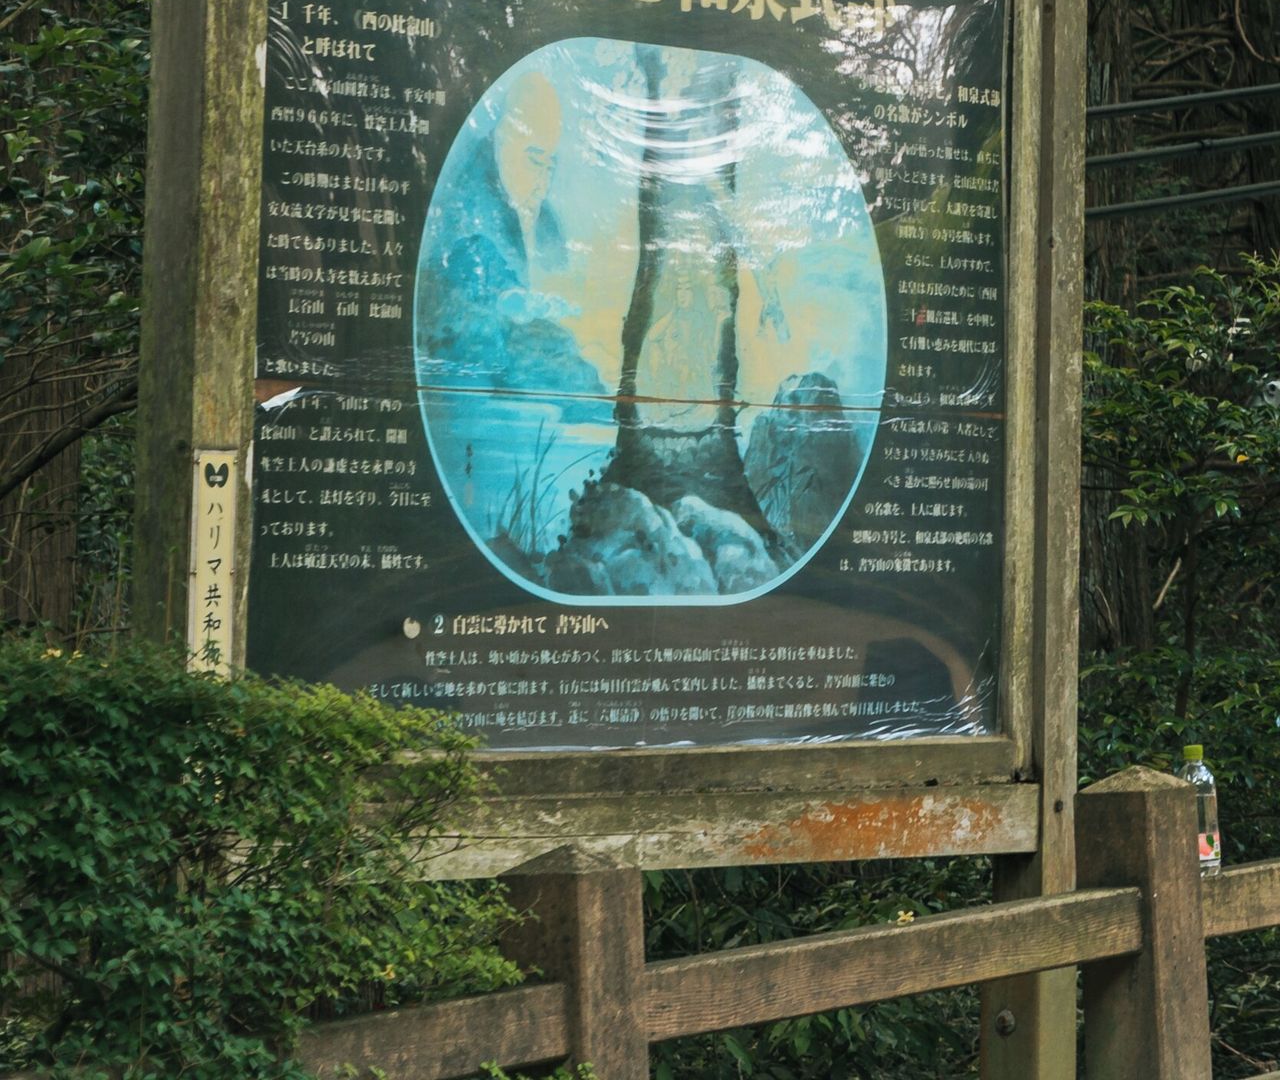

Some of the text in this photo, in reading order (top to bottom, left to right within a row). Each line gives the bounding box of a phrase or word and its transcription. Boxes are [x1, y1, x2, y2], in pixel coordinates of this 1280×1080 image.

[301, 36, 377, 62] と呼ばれて
[874, 105, 968, 129] の名歌がシンボル
[281, 171, 411, 195] この時期はまた日本の平
[268, 201, 405, 226] 安女流文学が見事に花開い
[266, 265, 403, 289] は当時の大寺を数えあげて
[260, 522, 335, 538] っております。
[453, 614, 547, 635] 白雲に導かれて
[556, 615, 609, 635] 書写山へ
